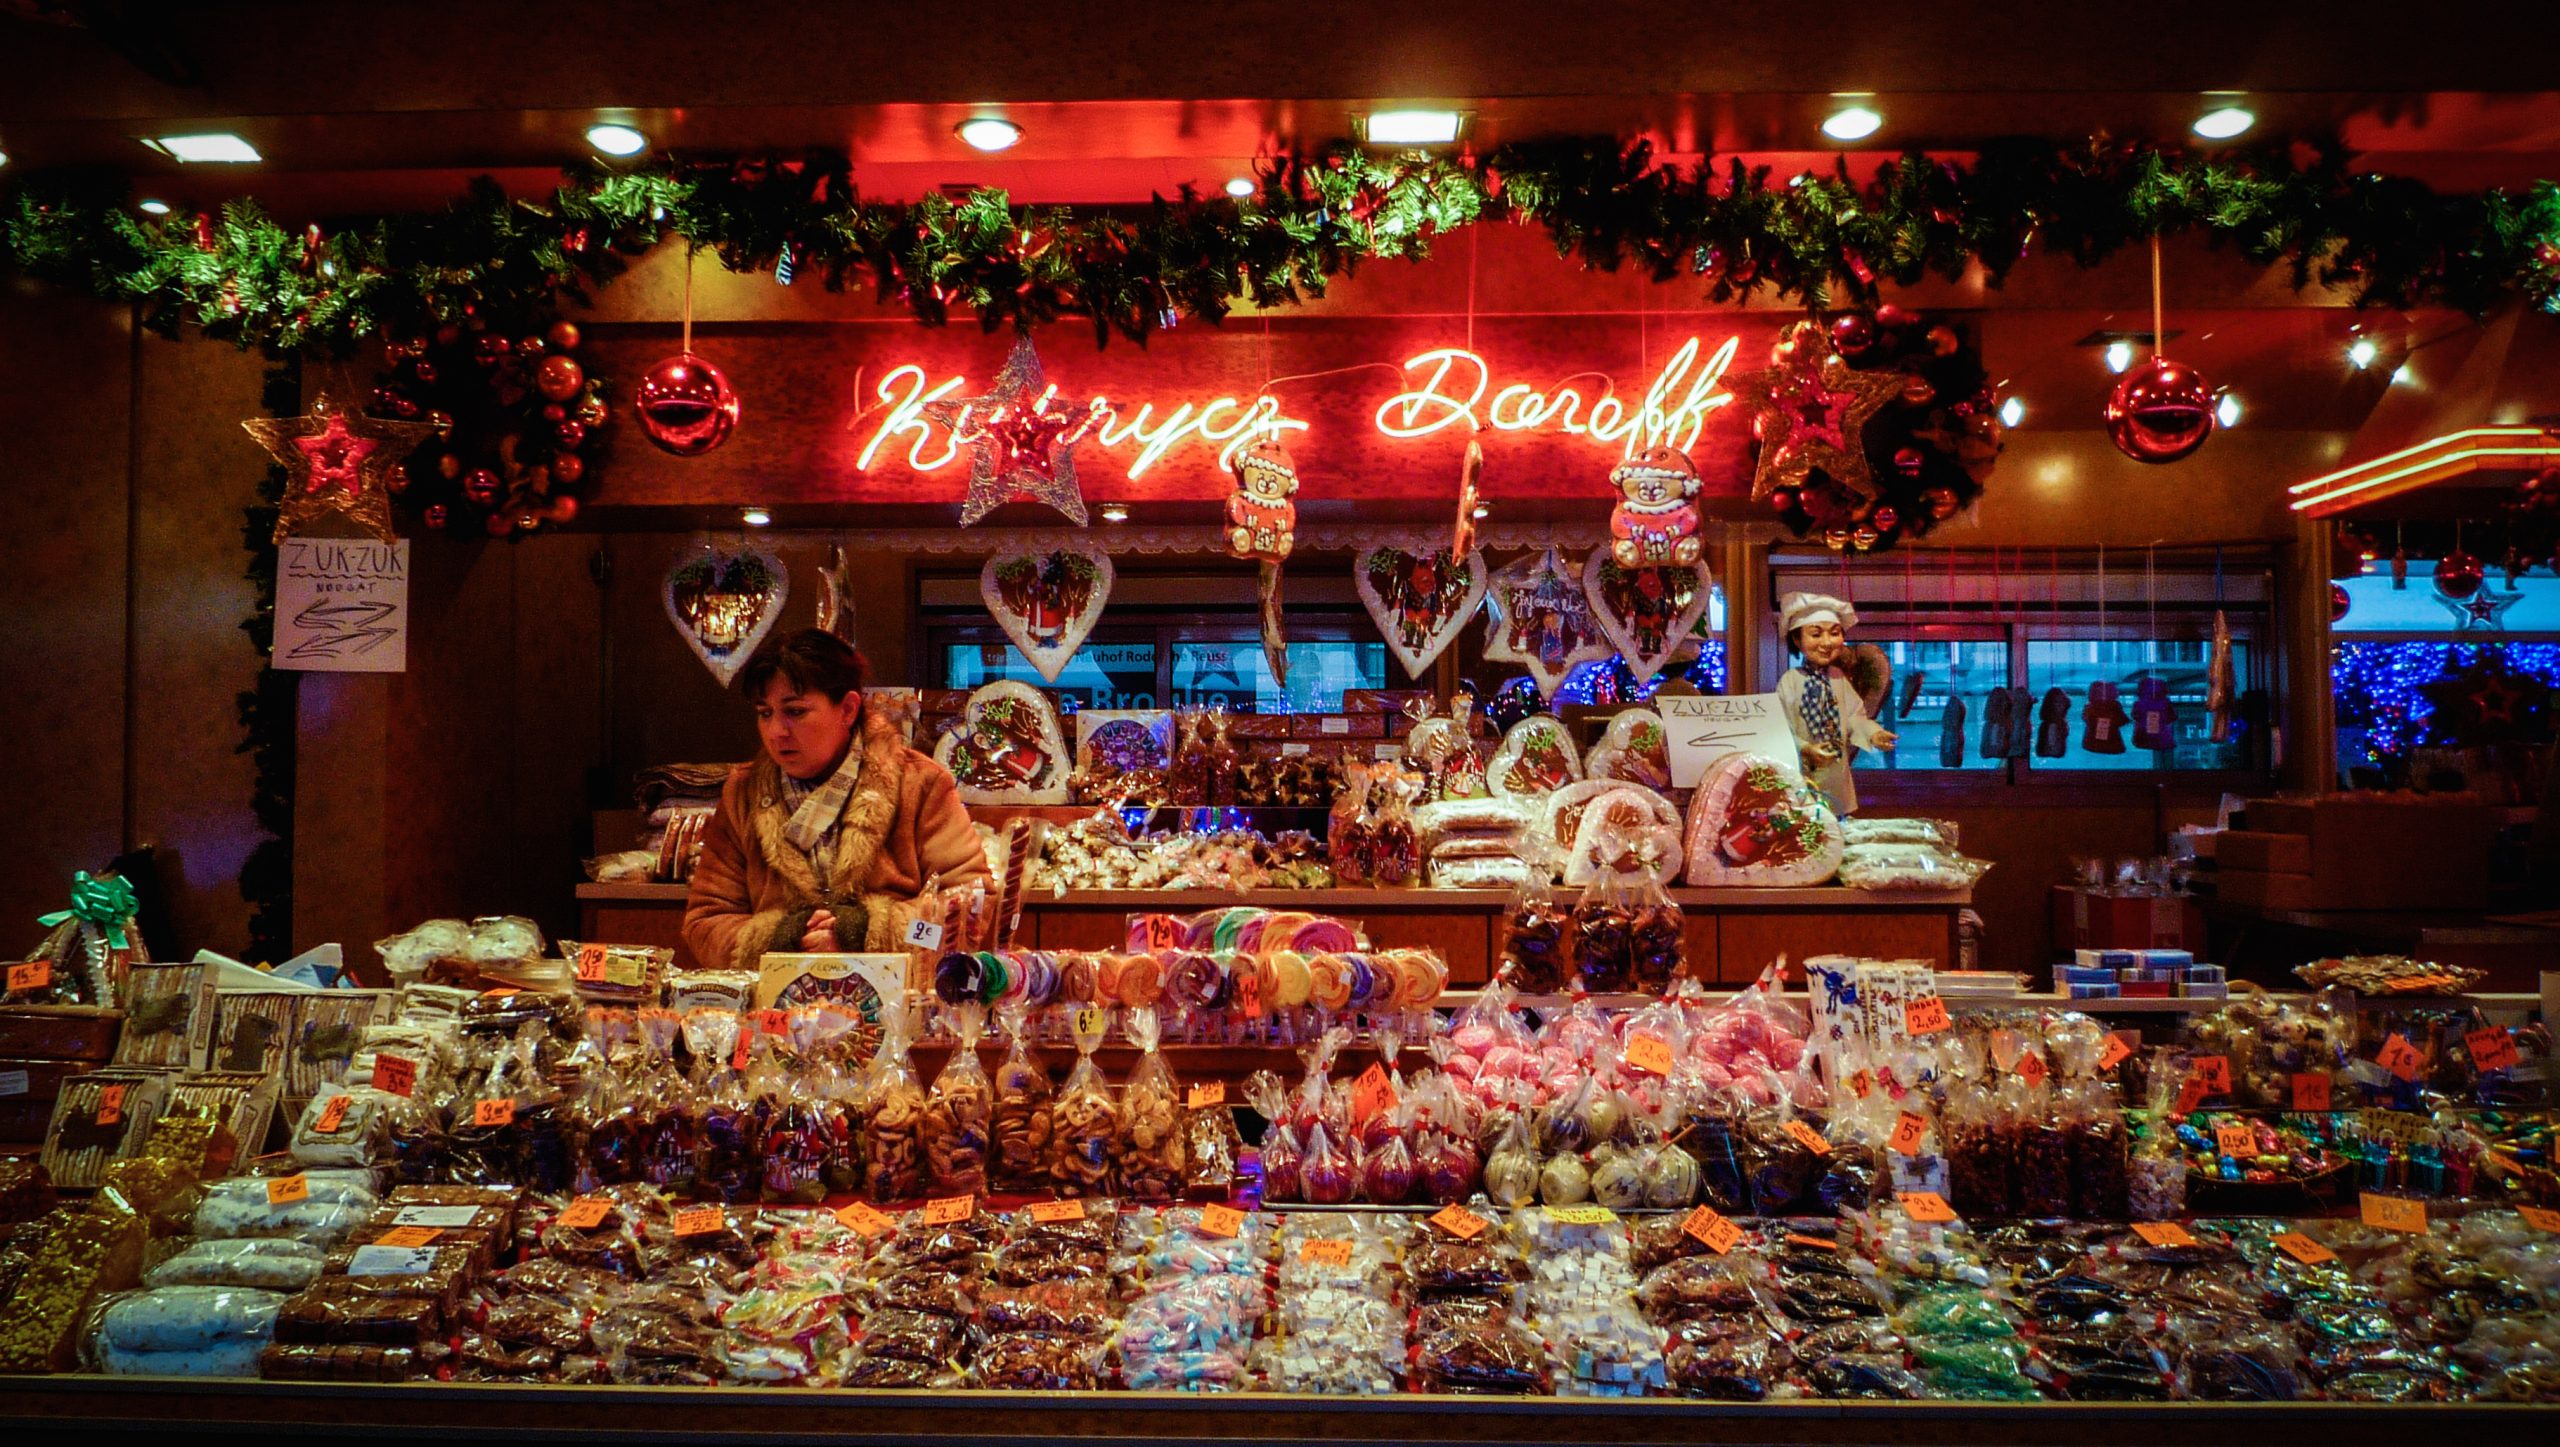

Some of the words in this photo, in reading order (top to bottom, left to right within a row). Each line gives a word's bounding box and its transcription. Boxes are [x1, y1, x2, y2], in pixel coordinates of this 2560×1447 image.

[287, 543, 403, 573] ZUK-ZUK
[912, 921, 933, 942] 2€
[1213, 1211, 1239, 1232] 2€
